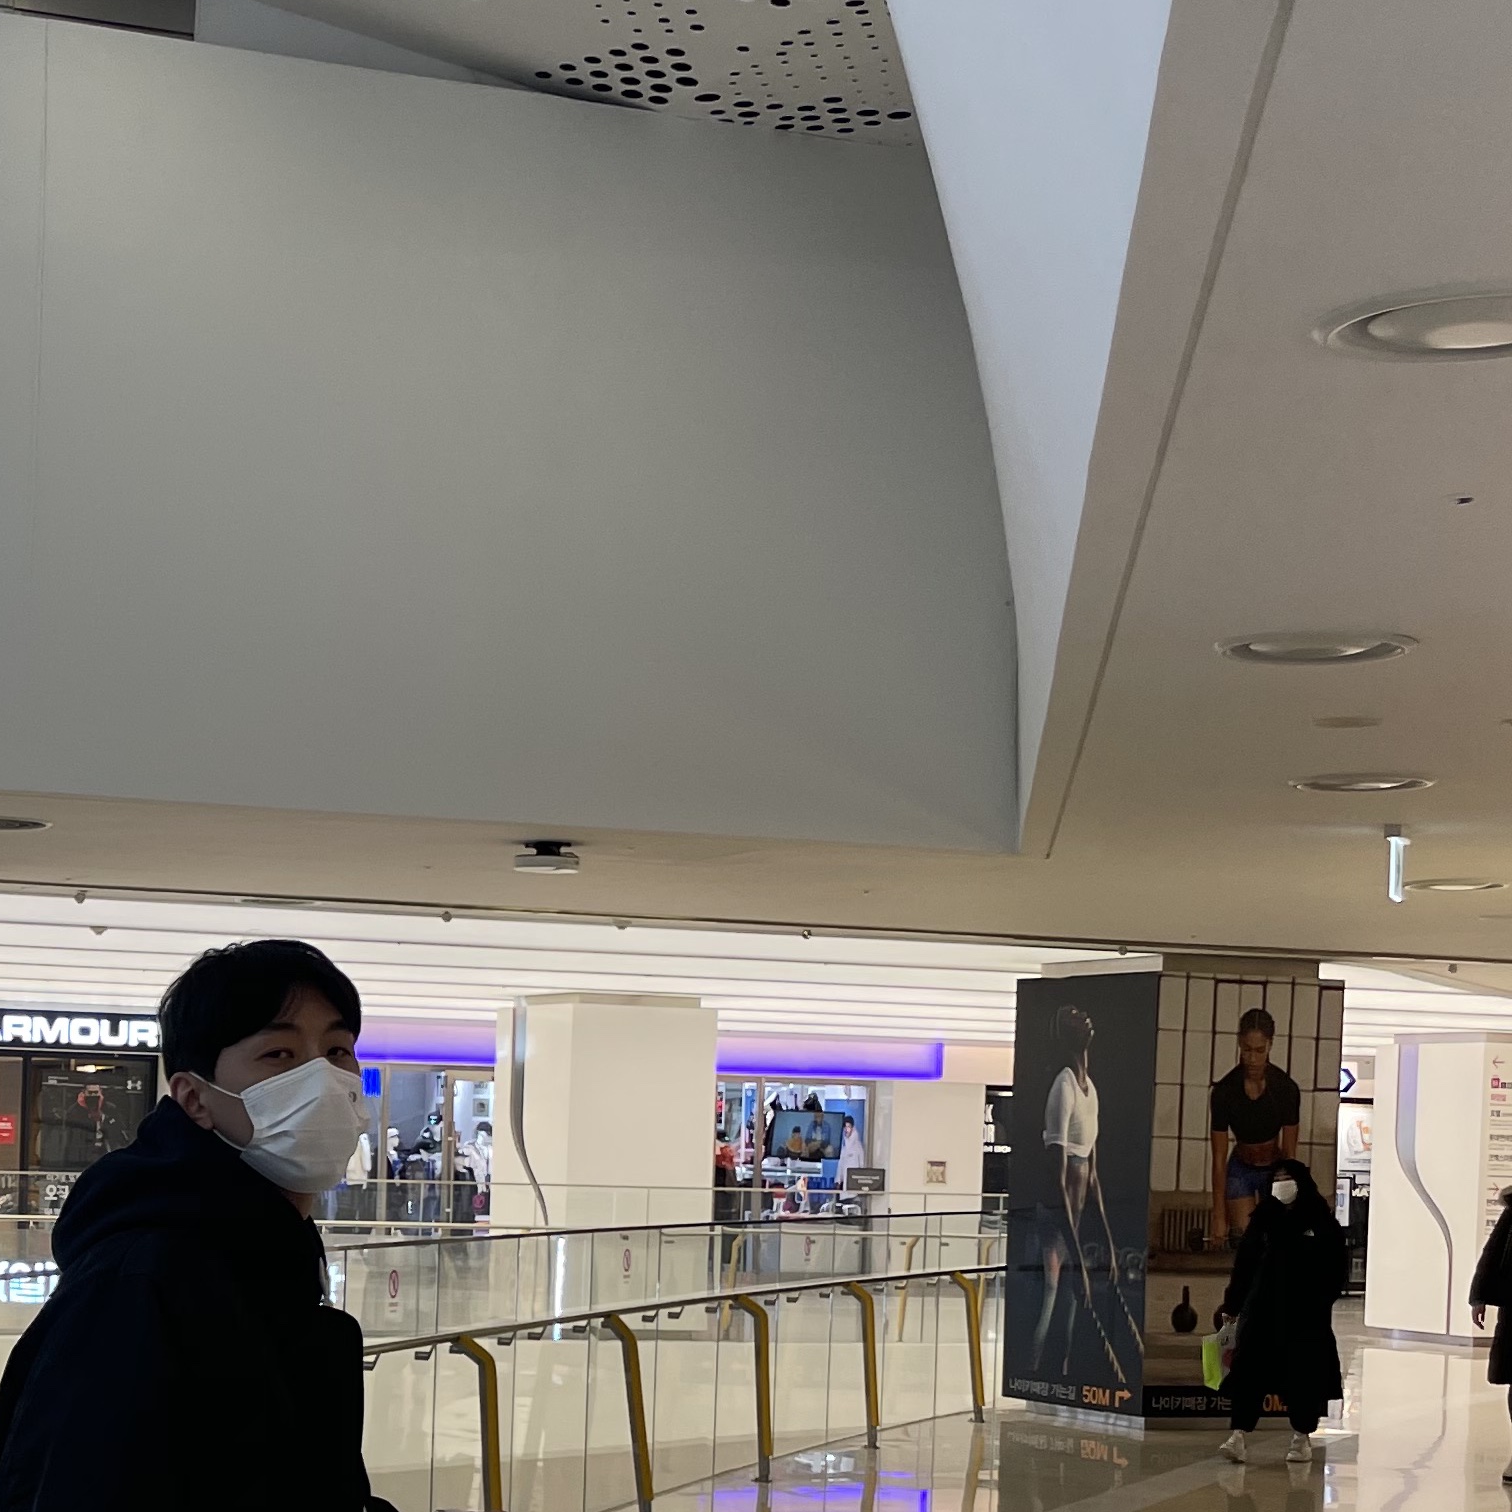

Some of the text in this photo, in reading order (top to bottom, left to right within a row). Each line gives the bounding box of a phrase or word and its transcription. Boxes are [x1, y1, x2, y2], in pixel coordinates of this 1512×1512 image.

[1081, 1385, 1110, 1406] 50M
[1151, 1396, 1207, 1411] 나이키매장
[1210, 1396, 1232, 1411] 가는
